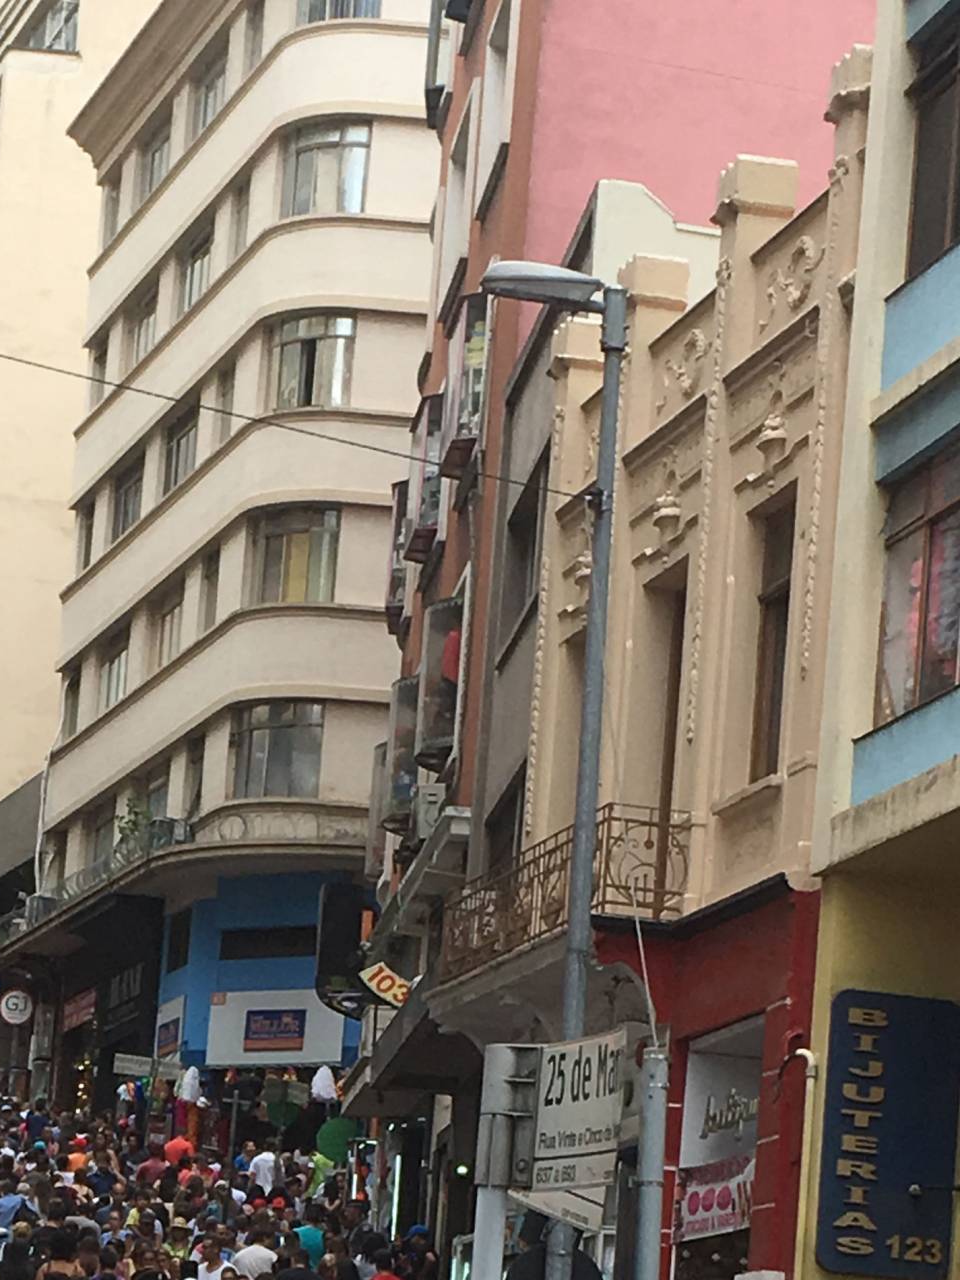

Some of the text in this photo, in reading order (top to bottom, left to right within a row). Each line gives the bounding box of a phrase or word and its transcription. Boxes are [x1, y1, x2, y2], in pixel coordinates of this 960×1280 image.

[367, 965, 411, 1004] 103
[544, 1052, 566, 1107] 25
[571, 1045, 591, 1102] de
[539, 1131, 556, 1149] Rua
[833, 1006, 889, 1256] BIJUTERIAS
[885, 1234, 942, 1264] 123
